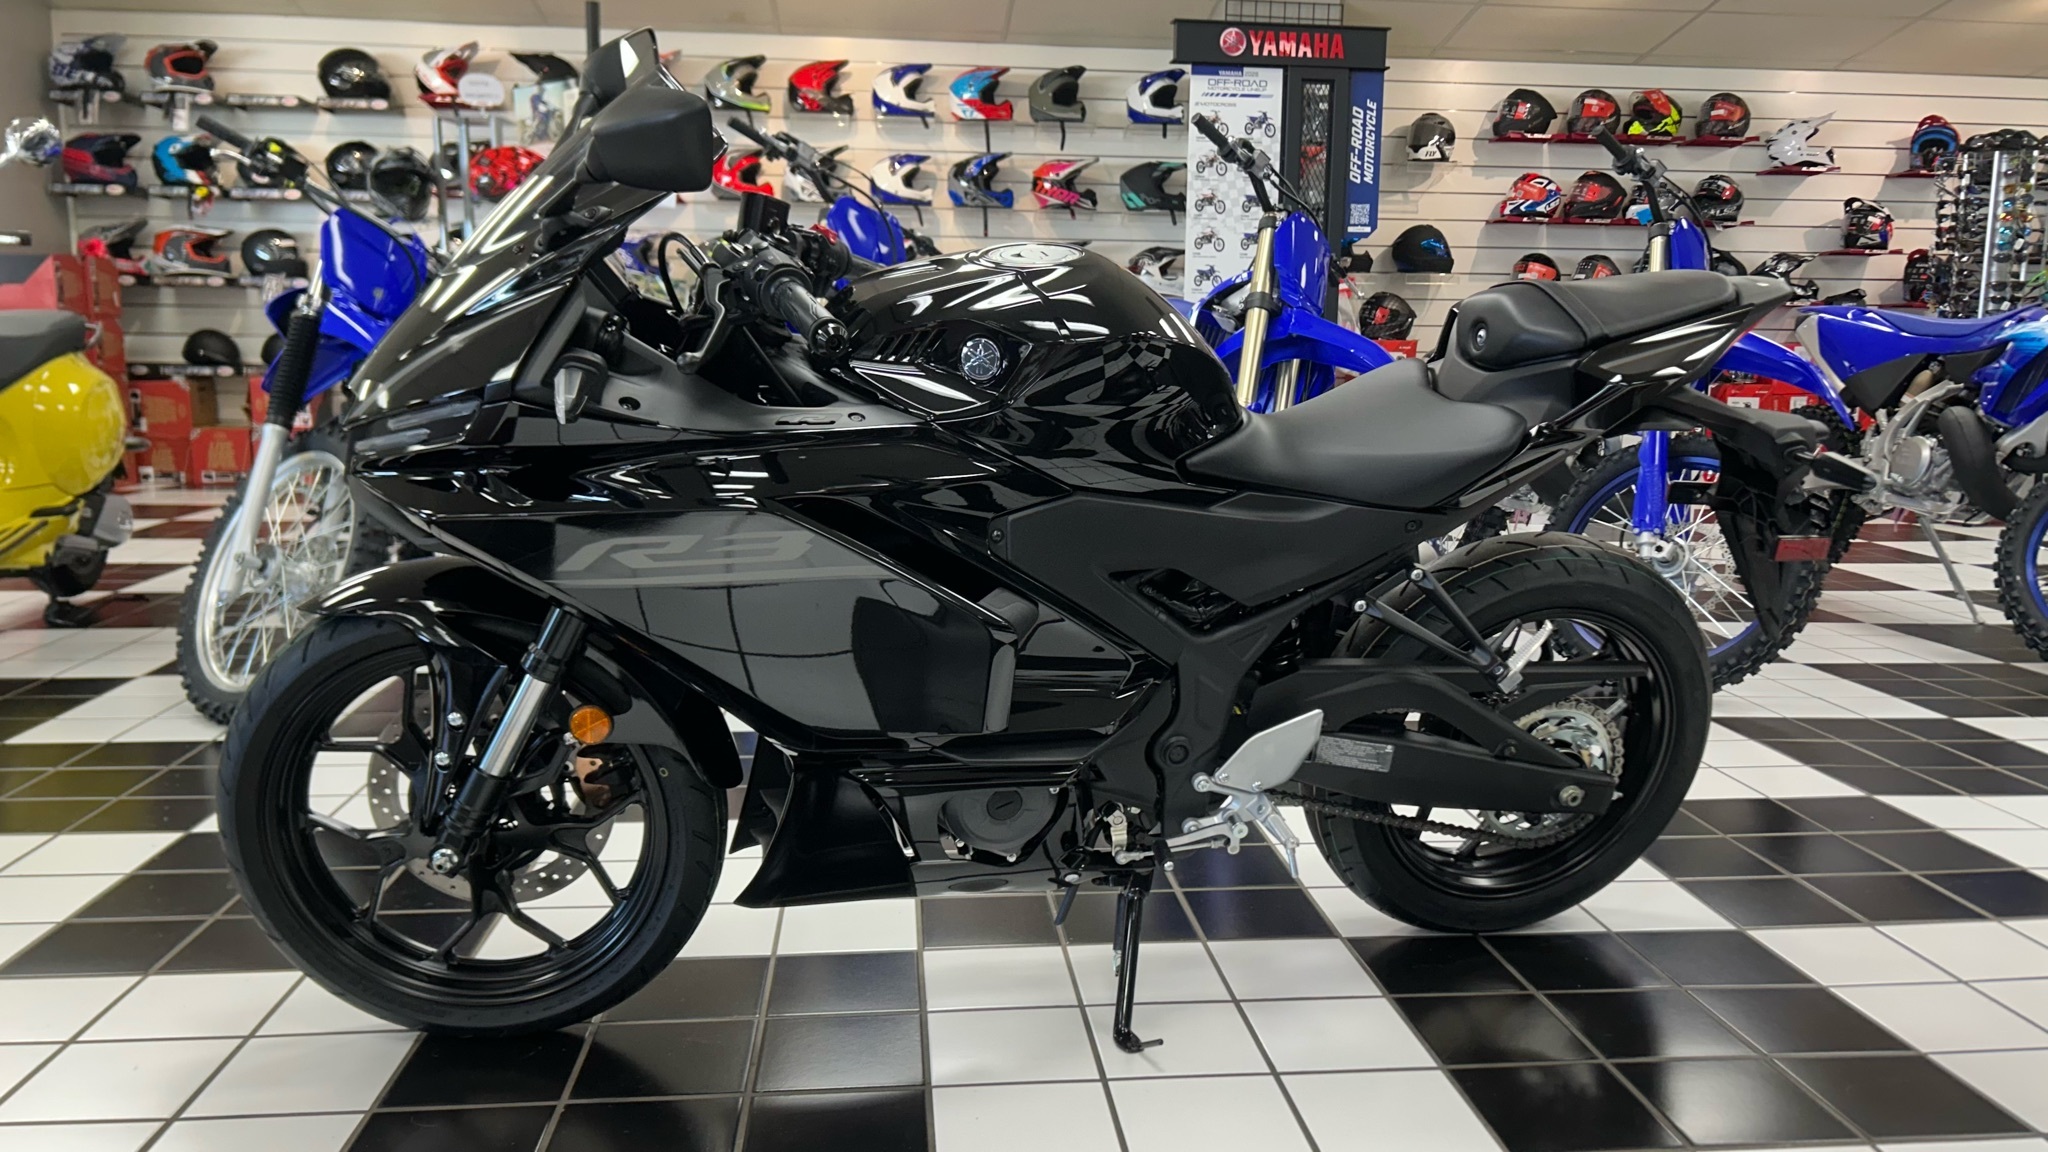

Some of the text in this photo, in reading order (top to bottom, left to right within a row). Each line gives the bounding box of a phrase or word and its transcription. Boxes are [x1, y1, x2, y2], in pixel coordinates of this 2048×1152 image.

[1249, 30, 1344, 59] YAMAHA
[1207, 78, 1268, 87] OFF-ROAD
[1349, 105, 1364, 185] OFF-ROAD
[1363, 98, 1377, 185] MOTORCYCLE
[1034, 180, 1081, 204] THOR
[556, 530, 816, 572] R3
